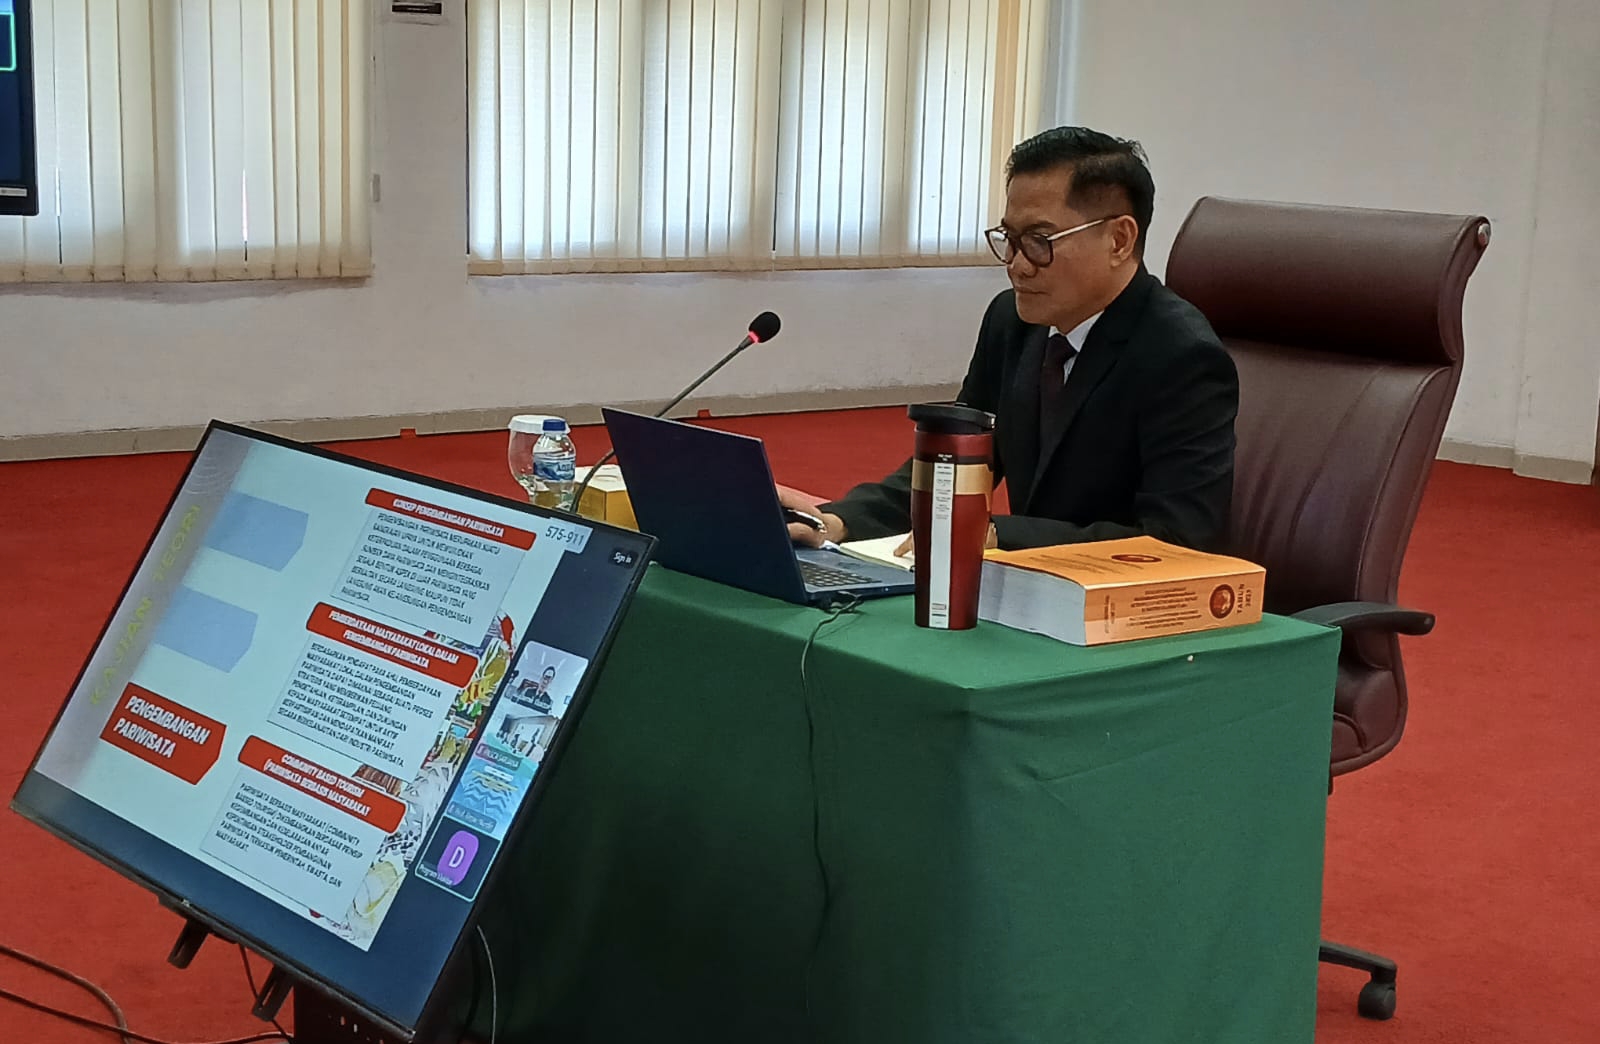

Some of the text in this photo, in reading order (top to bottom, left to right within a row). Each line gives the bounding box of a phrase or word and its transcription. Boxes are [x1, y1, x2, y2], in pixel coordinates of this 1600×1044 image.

[545, 526, 586, 547] 575-911
[124, 694, 211, 746] PENGEMBANGAN
[112, 716, 177, 759] PARIWISATA
[447, 845, 467, 869] D
